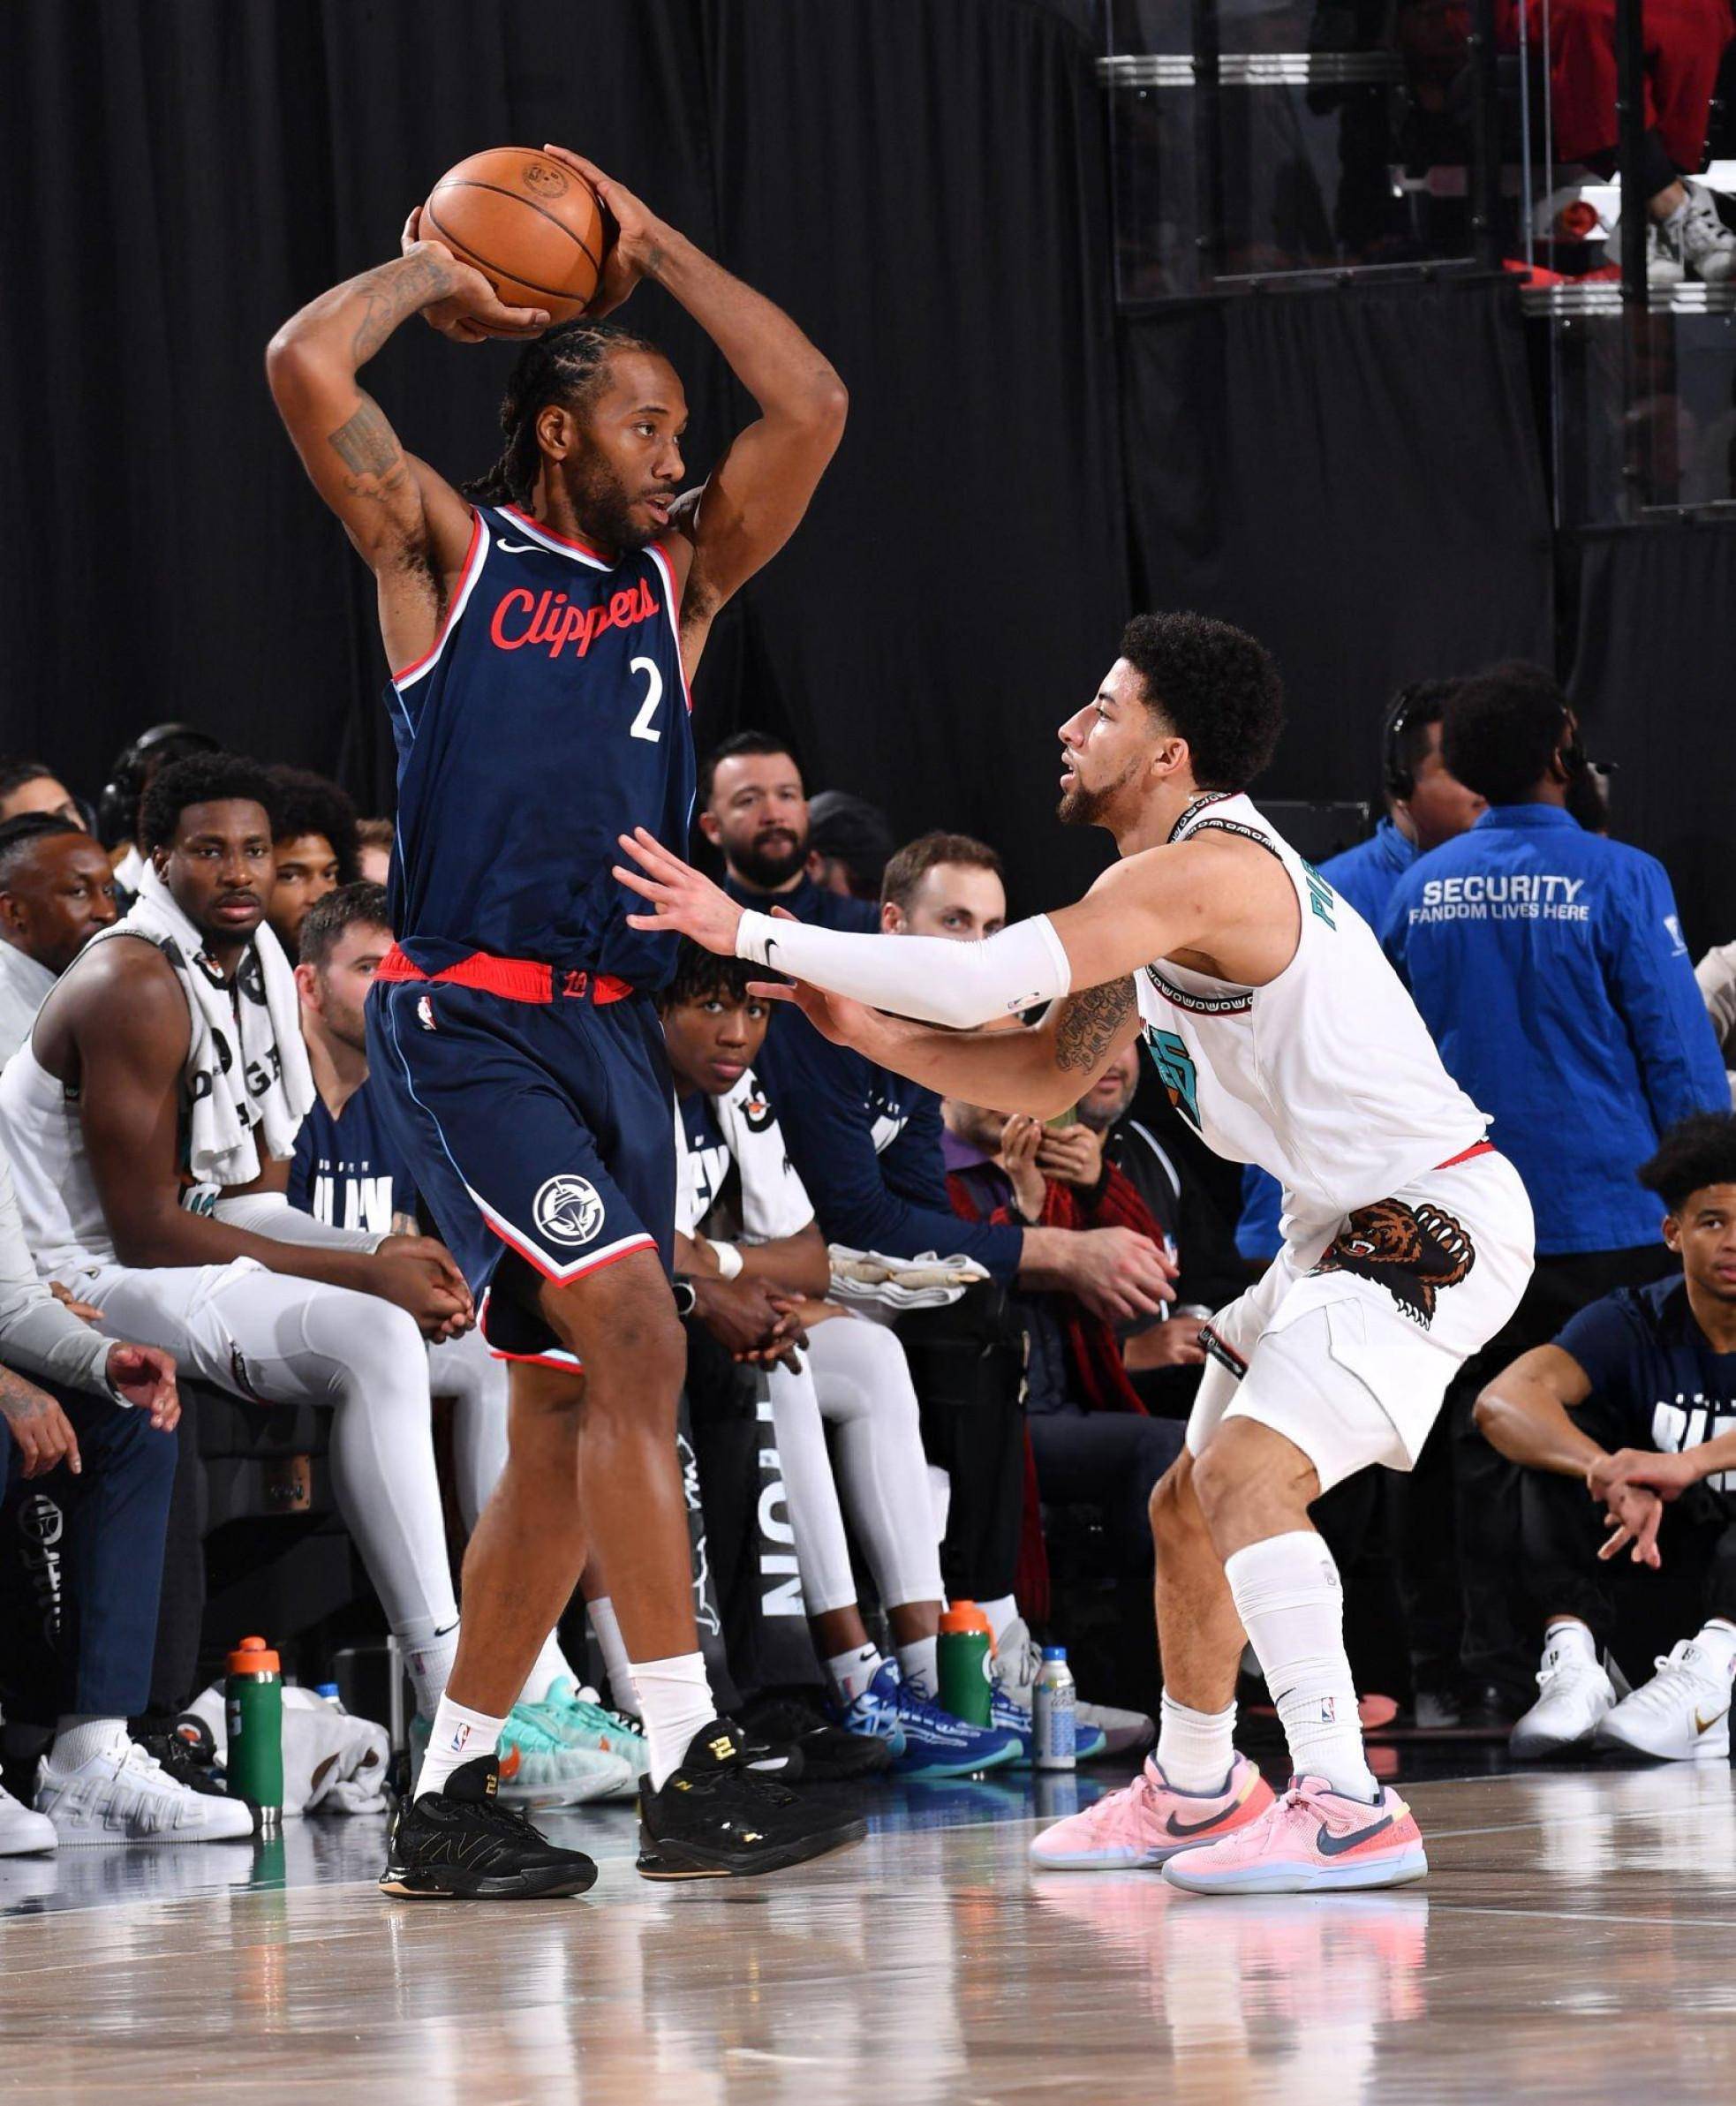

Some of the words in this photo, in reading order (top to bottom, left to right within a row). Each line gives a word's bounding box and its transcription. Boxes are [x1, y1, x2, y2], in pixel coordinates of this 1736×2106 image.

[490, 577, 660, 658] Clippers
[630, 656, 664, 743] 2
[1408, 902, 1487, 925] FANDOM
[1491, 902, 1539, 920] LIVES
[1544, 903, 1589, 921] HERE
[1423, 874, 1584, 906] SECURITY
